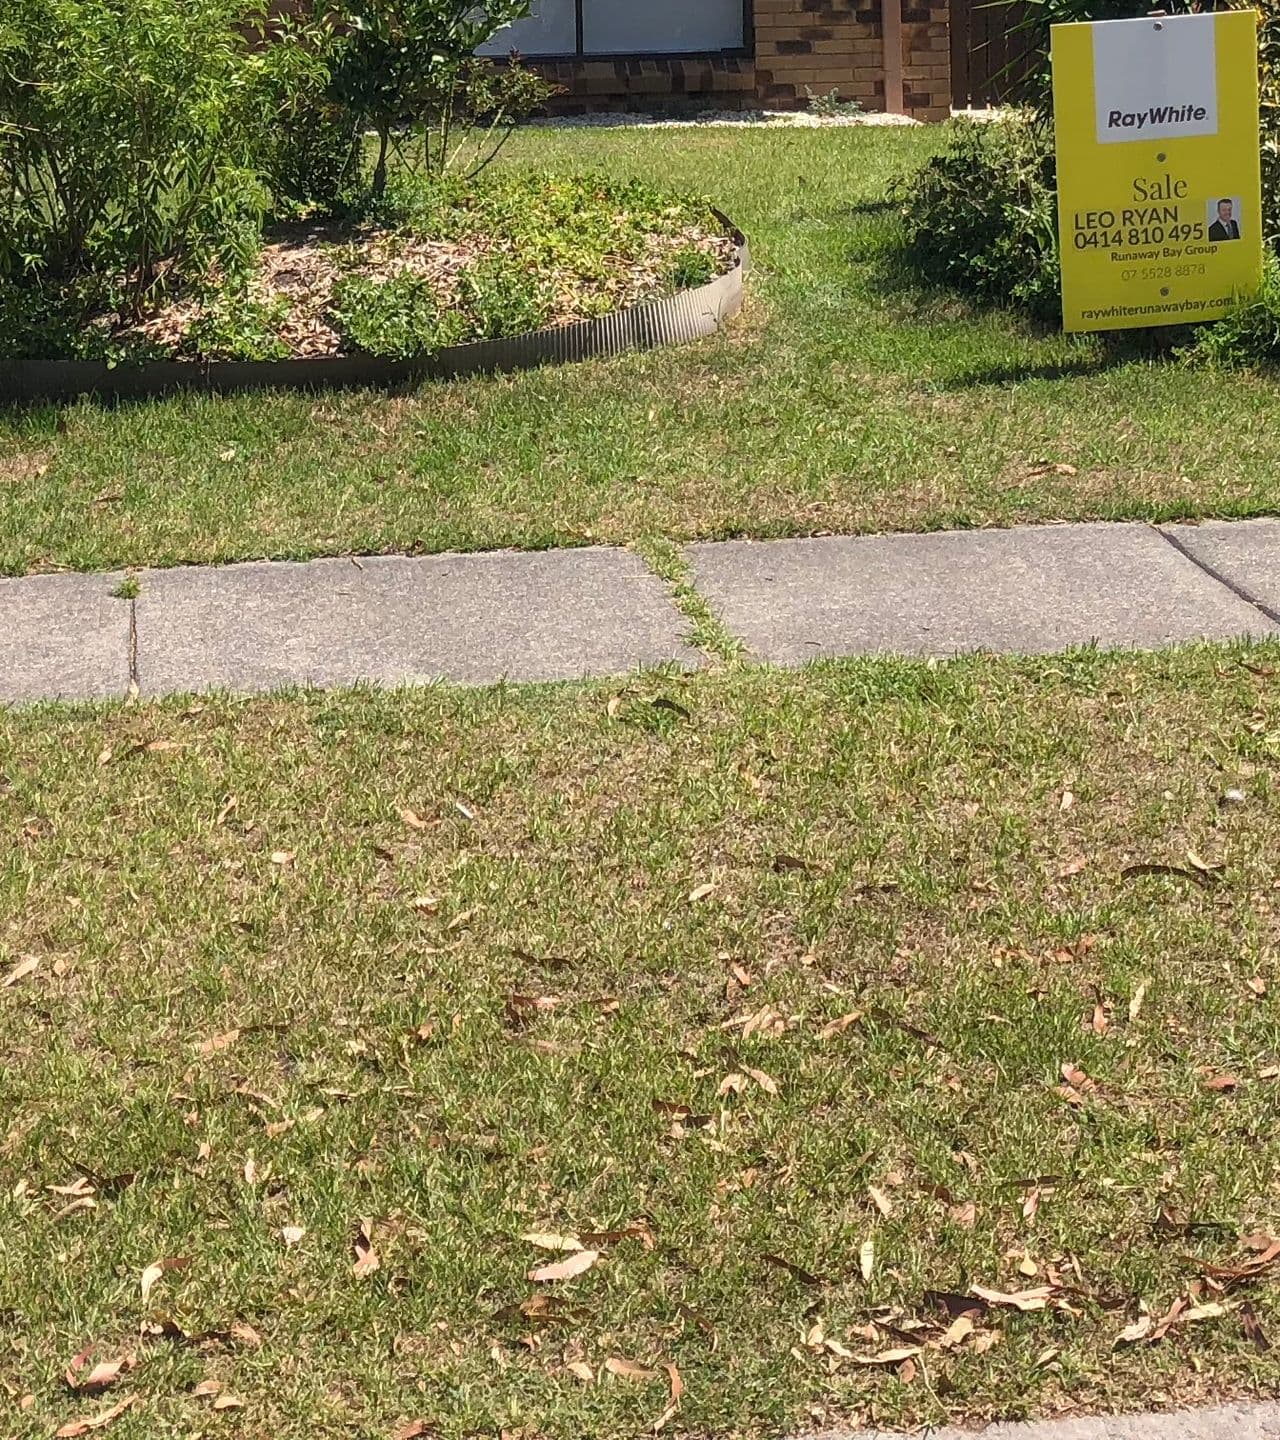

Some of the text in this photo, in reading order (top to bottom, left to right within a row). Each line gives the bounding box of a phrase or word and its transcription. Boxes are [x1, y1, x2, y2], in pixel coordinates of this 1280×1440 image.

[1108, 105, 1206, 129] RayWhite
[1133, 174, 1188, 202] Sale
[1074, 206, 1178, 230] LEO RYAN
[1074, 223, 1203, 249] 0414 810 495
[1111, 244, 1218, 262] Runaway Bay Group
[1121, 269, 1137, 281] 07
